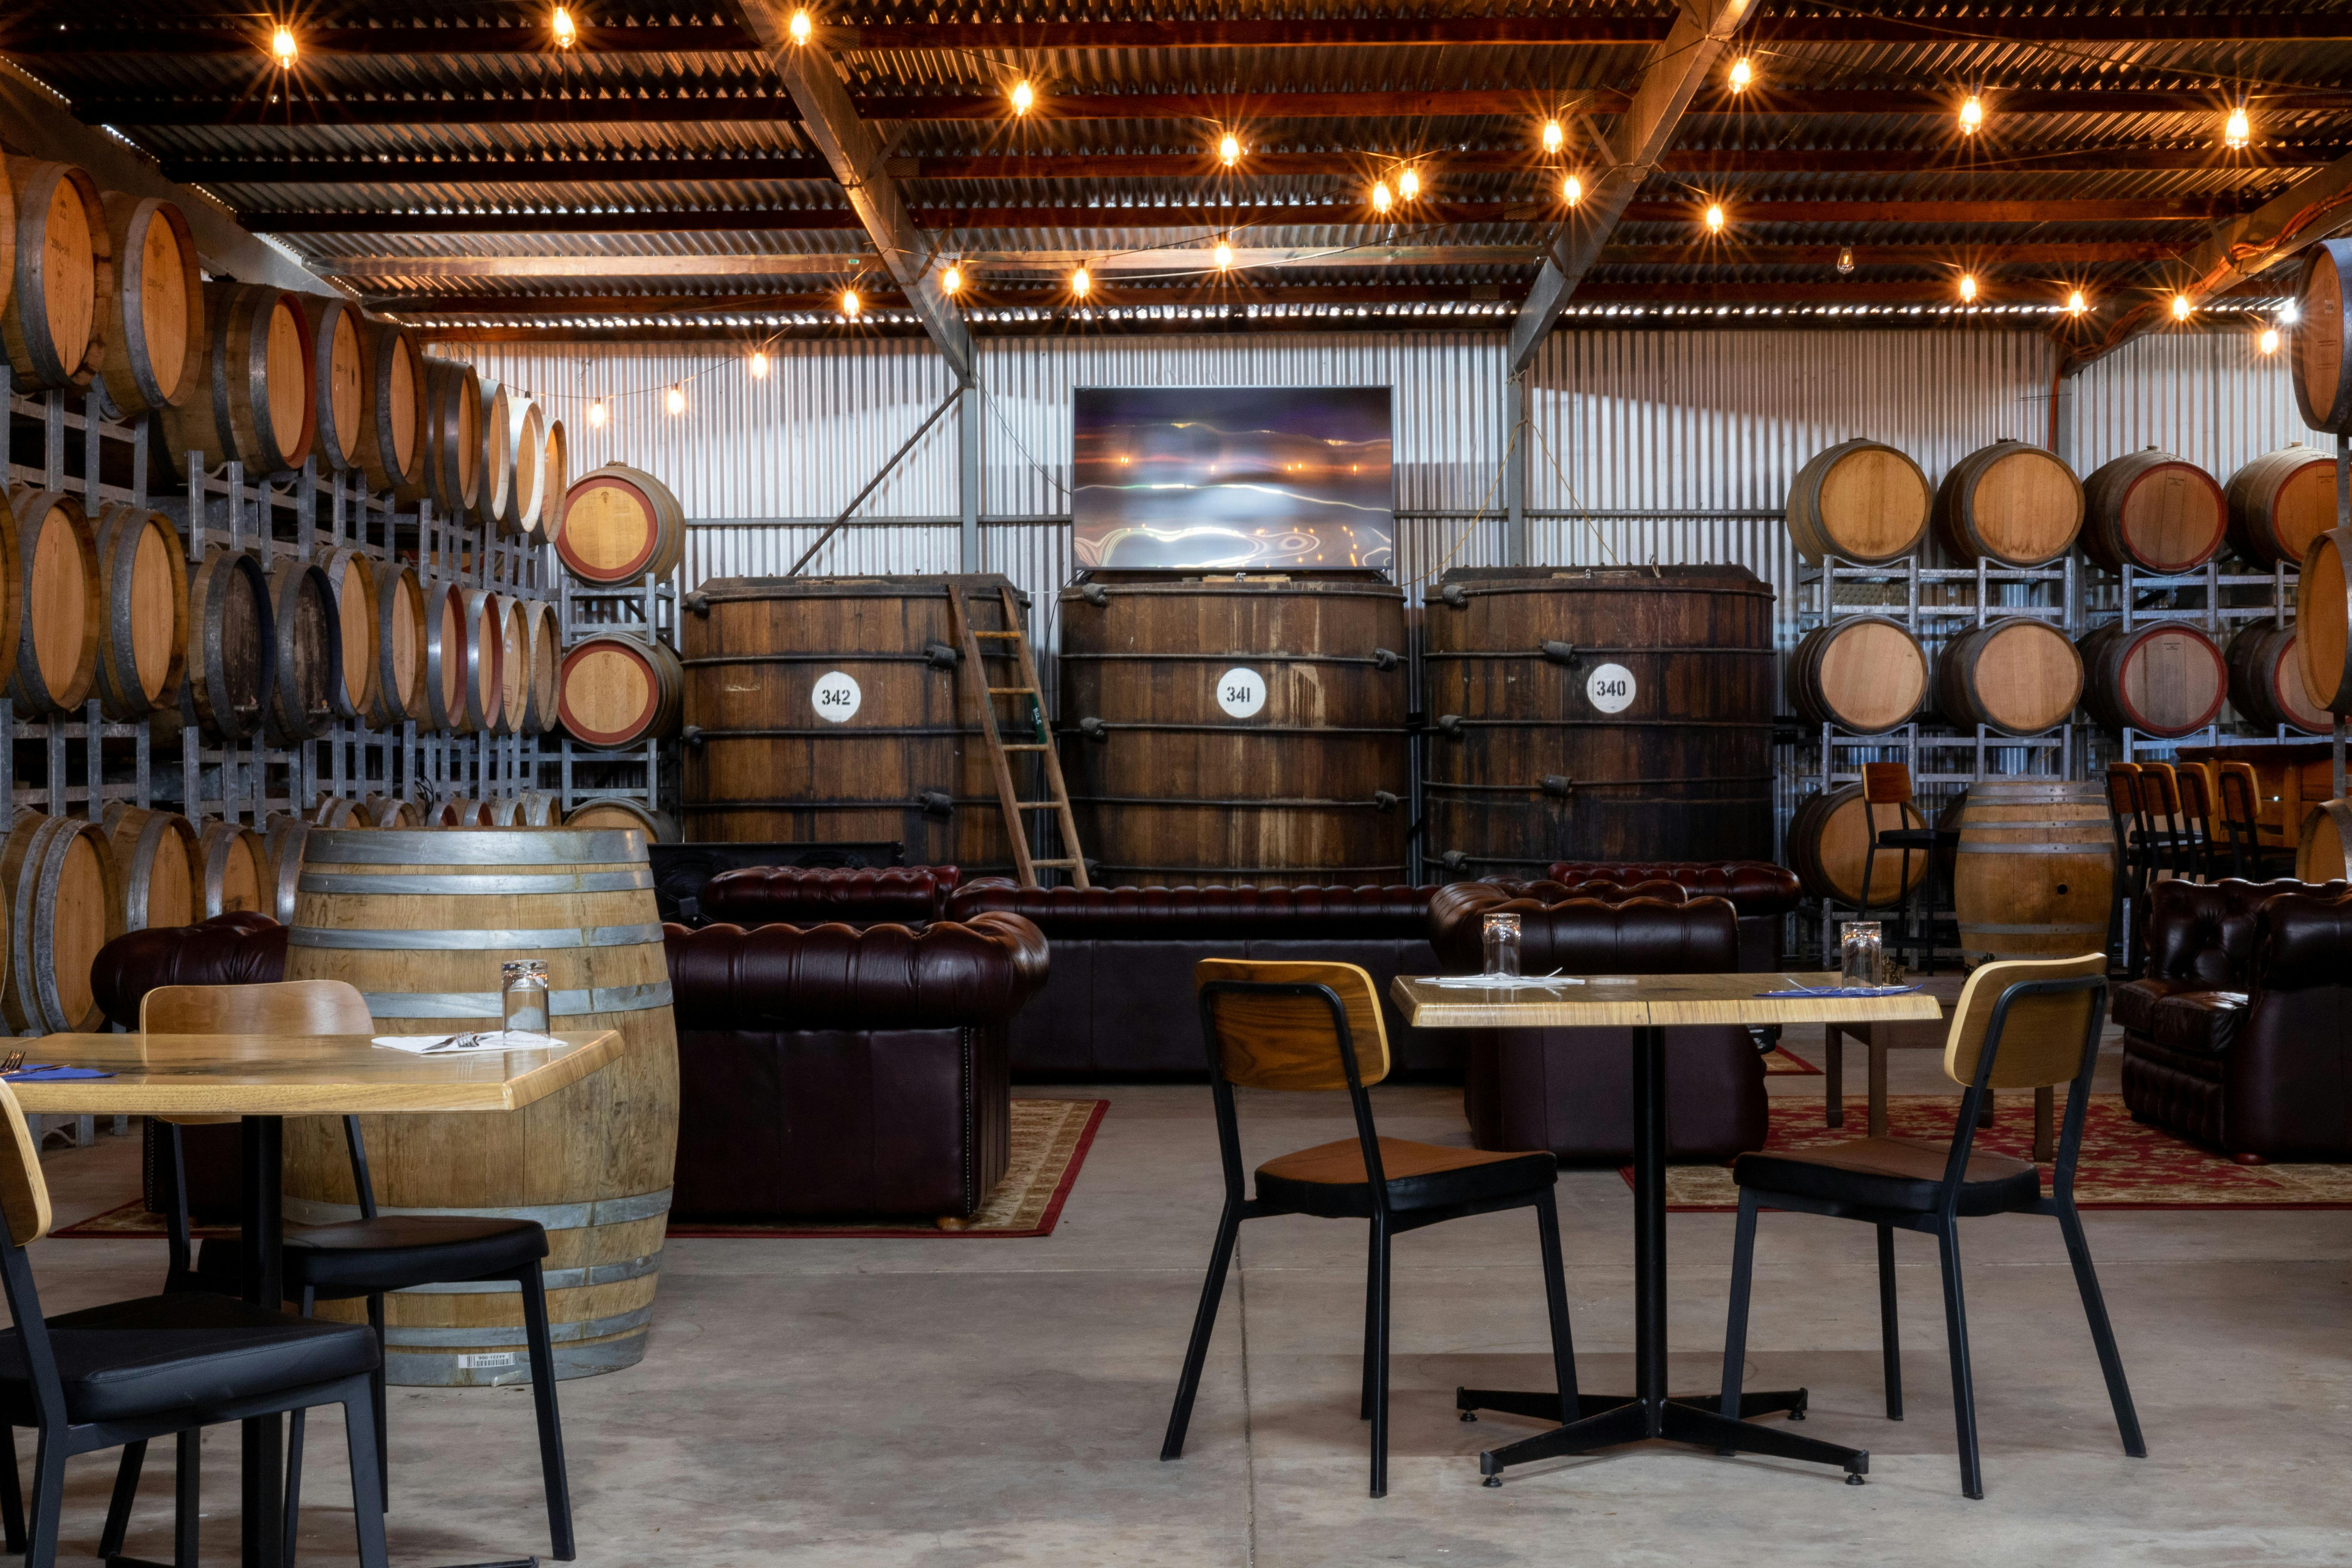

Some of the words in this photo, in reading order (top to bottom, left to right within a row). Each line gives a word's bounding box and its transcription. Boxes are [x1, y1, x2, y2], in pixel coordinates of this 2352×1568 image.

[1226, 686, 1250, 702] 341
[1597, 680, 1625, 696] 340
[822, 689, 850, 705] 342
